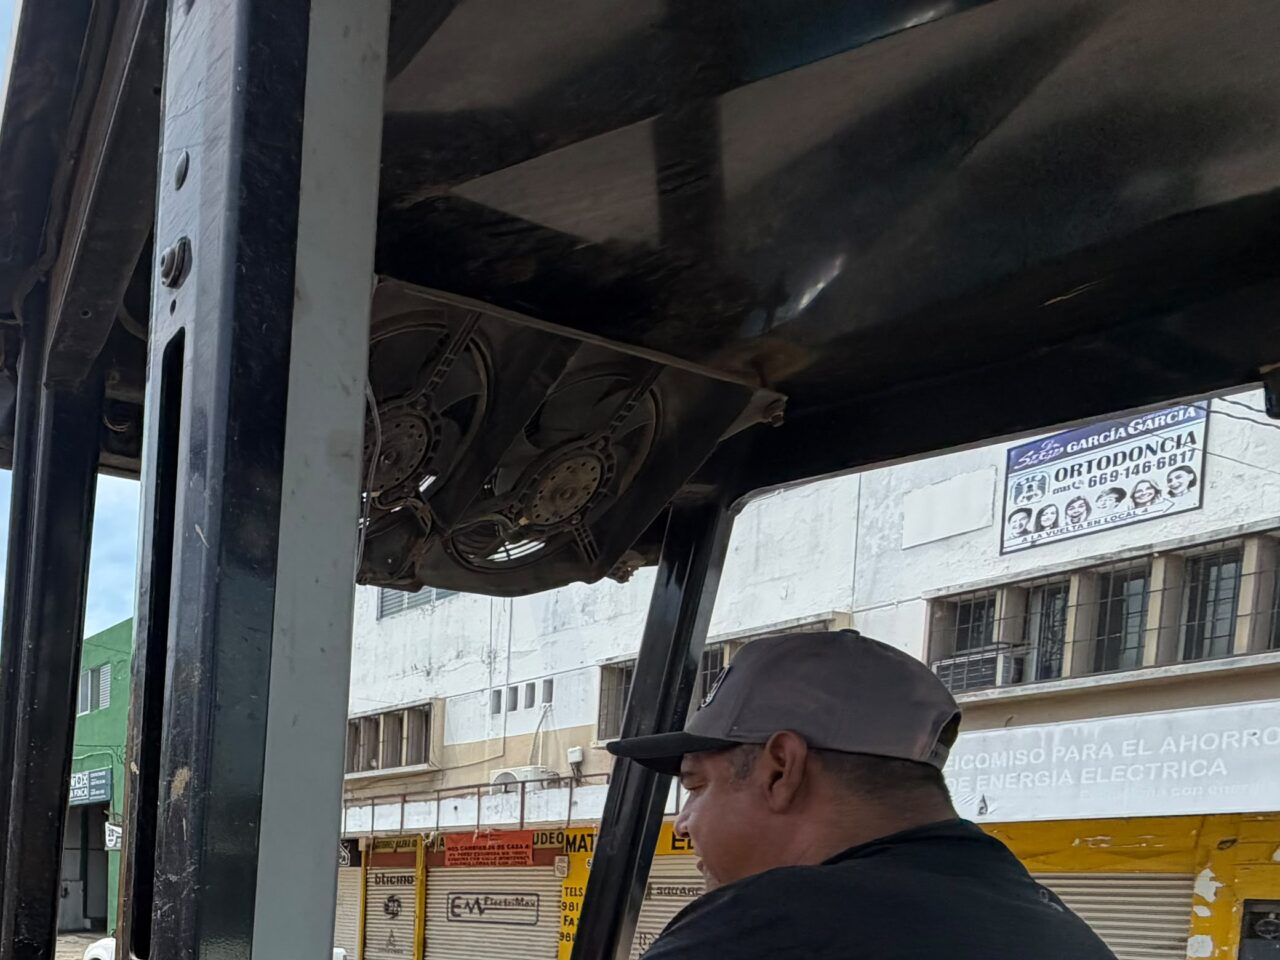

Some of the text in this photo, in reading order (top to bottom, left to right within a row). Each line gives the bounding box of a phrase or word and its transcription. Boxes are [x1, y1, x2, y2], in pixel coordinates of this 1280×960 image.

[1054, 430, 1197, 483] ORTODONCIA
[1066, 426, 1126, 454] GARCÍA
[1021, 535, 1029, 543] A
[1031, 532, 1043, 541] LA
[1045, 523, 1084, 537] VUELTA
[1104, 511, 1138, 526] LOCAL
[1051, 742, 1114, 763] PARA
[1121, 738, 1153, 757] EL
[1160, 726, 1280, 754] AHORRO
[944, 757, 1228, 793] DE ENERGIA ELECTRICA
[374, 873, 414, 886] bticino
